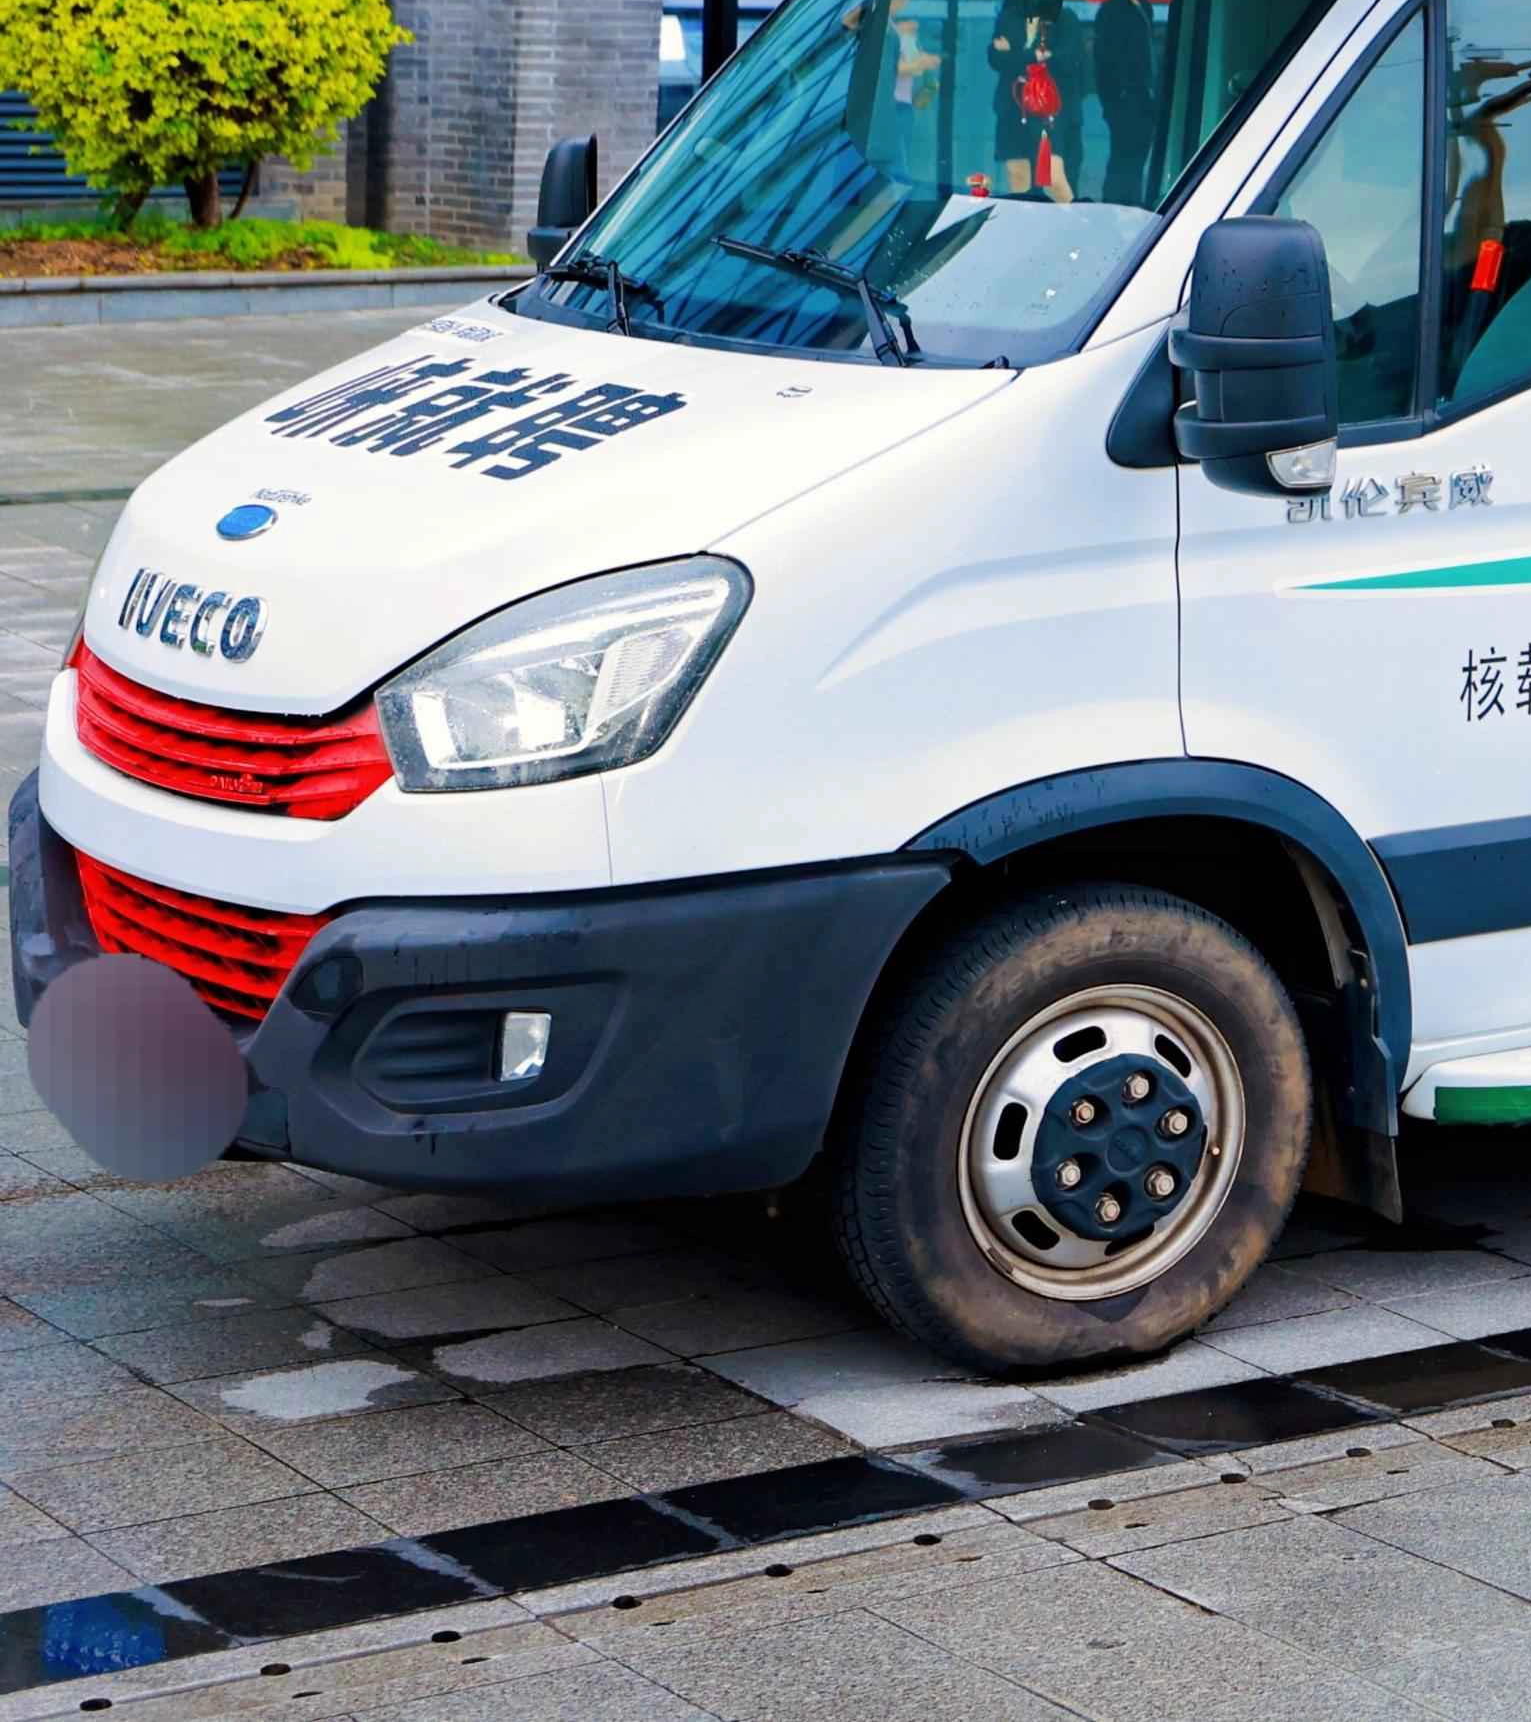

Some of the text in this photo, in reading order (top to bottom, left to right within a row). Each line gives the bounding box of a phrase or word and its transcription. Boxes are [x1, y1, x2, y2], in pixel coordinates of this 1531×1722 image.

[264, 355, 688, 481] 崃就聘
[118, 567, 269, 663] IVECO
